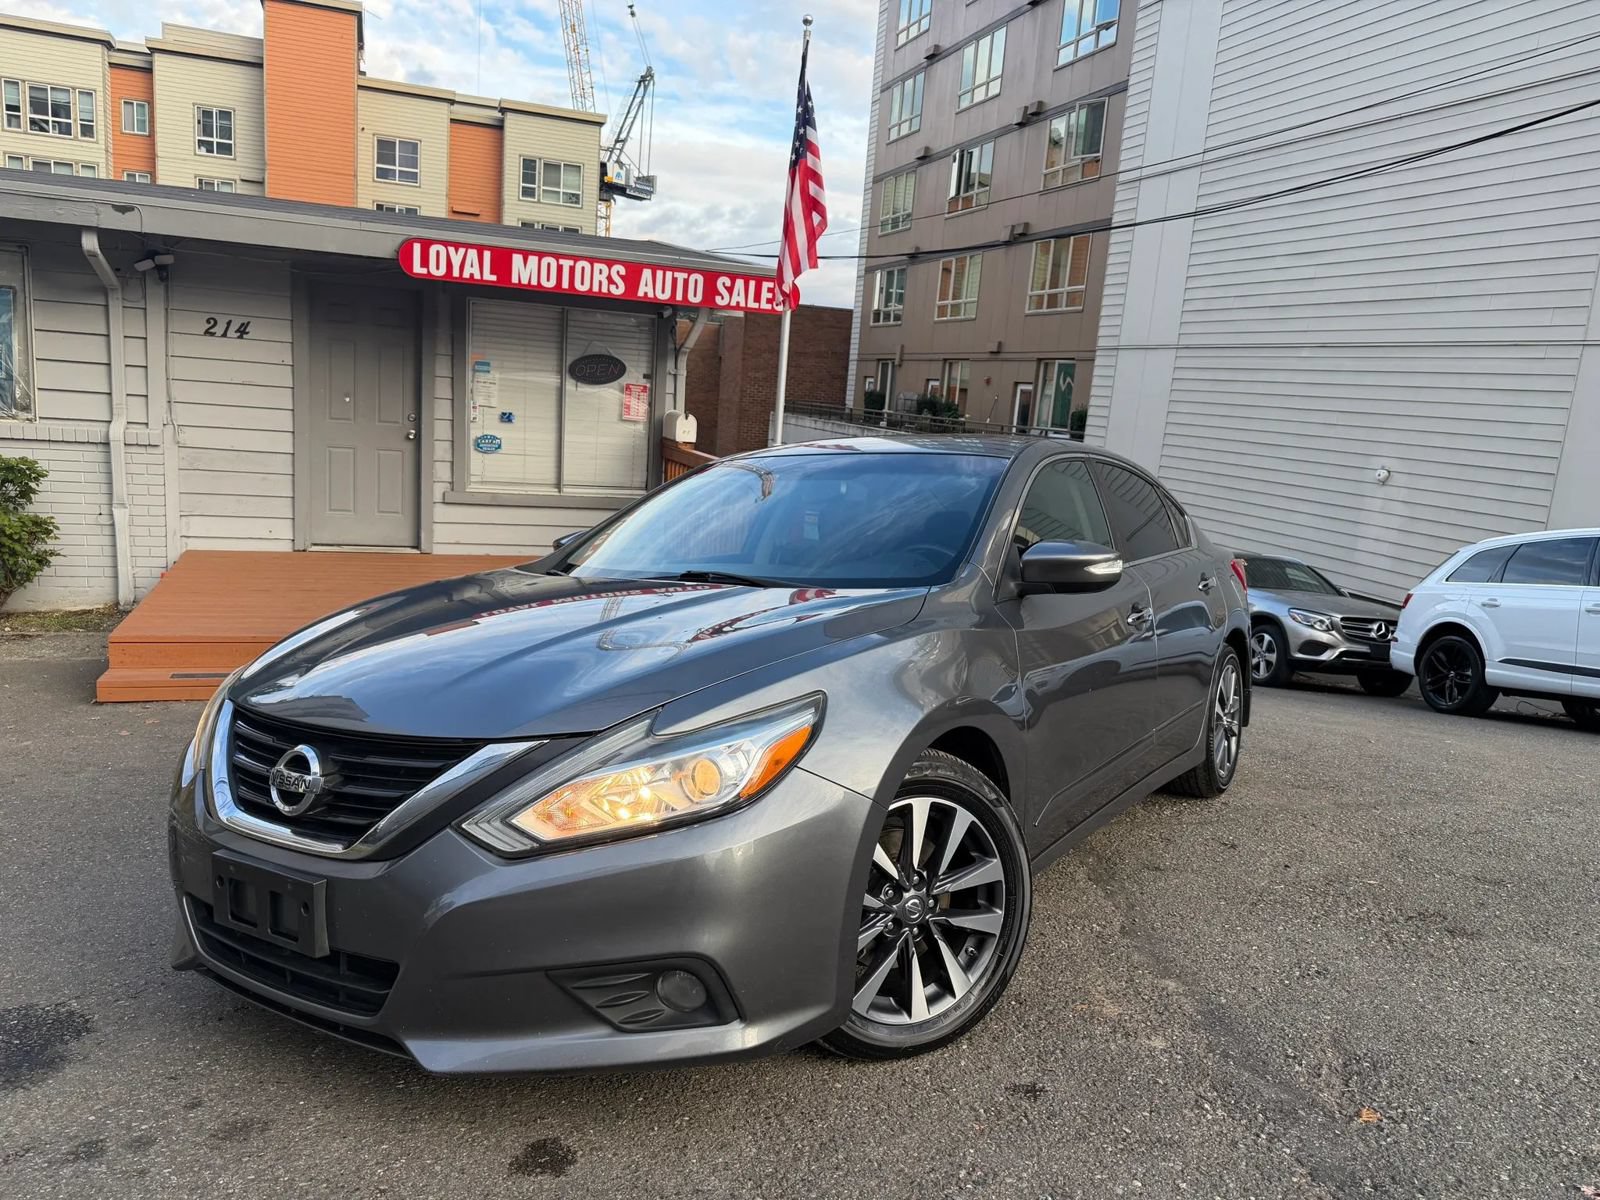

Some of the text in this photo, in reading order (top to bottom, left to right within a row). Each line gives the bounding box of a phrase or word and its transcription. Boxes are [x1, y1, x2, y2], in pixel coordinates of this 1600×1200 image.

[412, 242, 498, 282] LOYAL
[511, 253, 627, 296] MOTORS
[637, 268, 704, 304] AUTO
[203, 317, 251, 339] 214
[575, 363, 621, 377] OPEN
[270, 769, 312, 790] NISSAN
